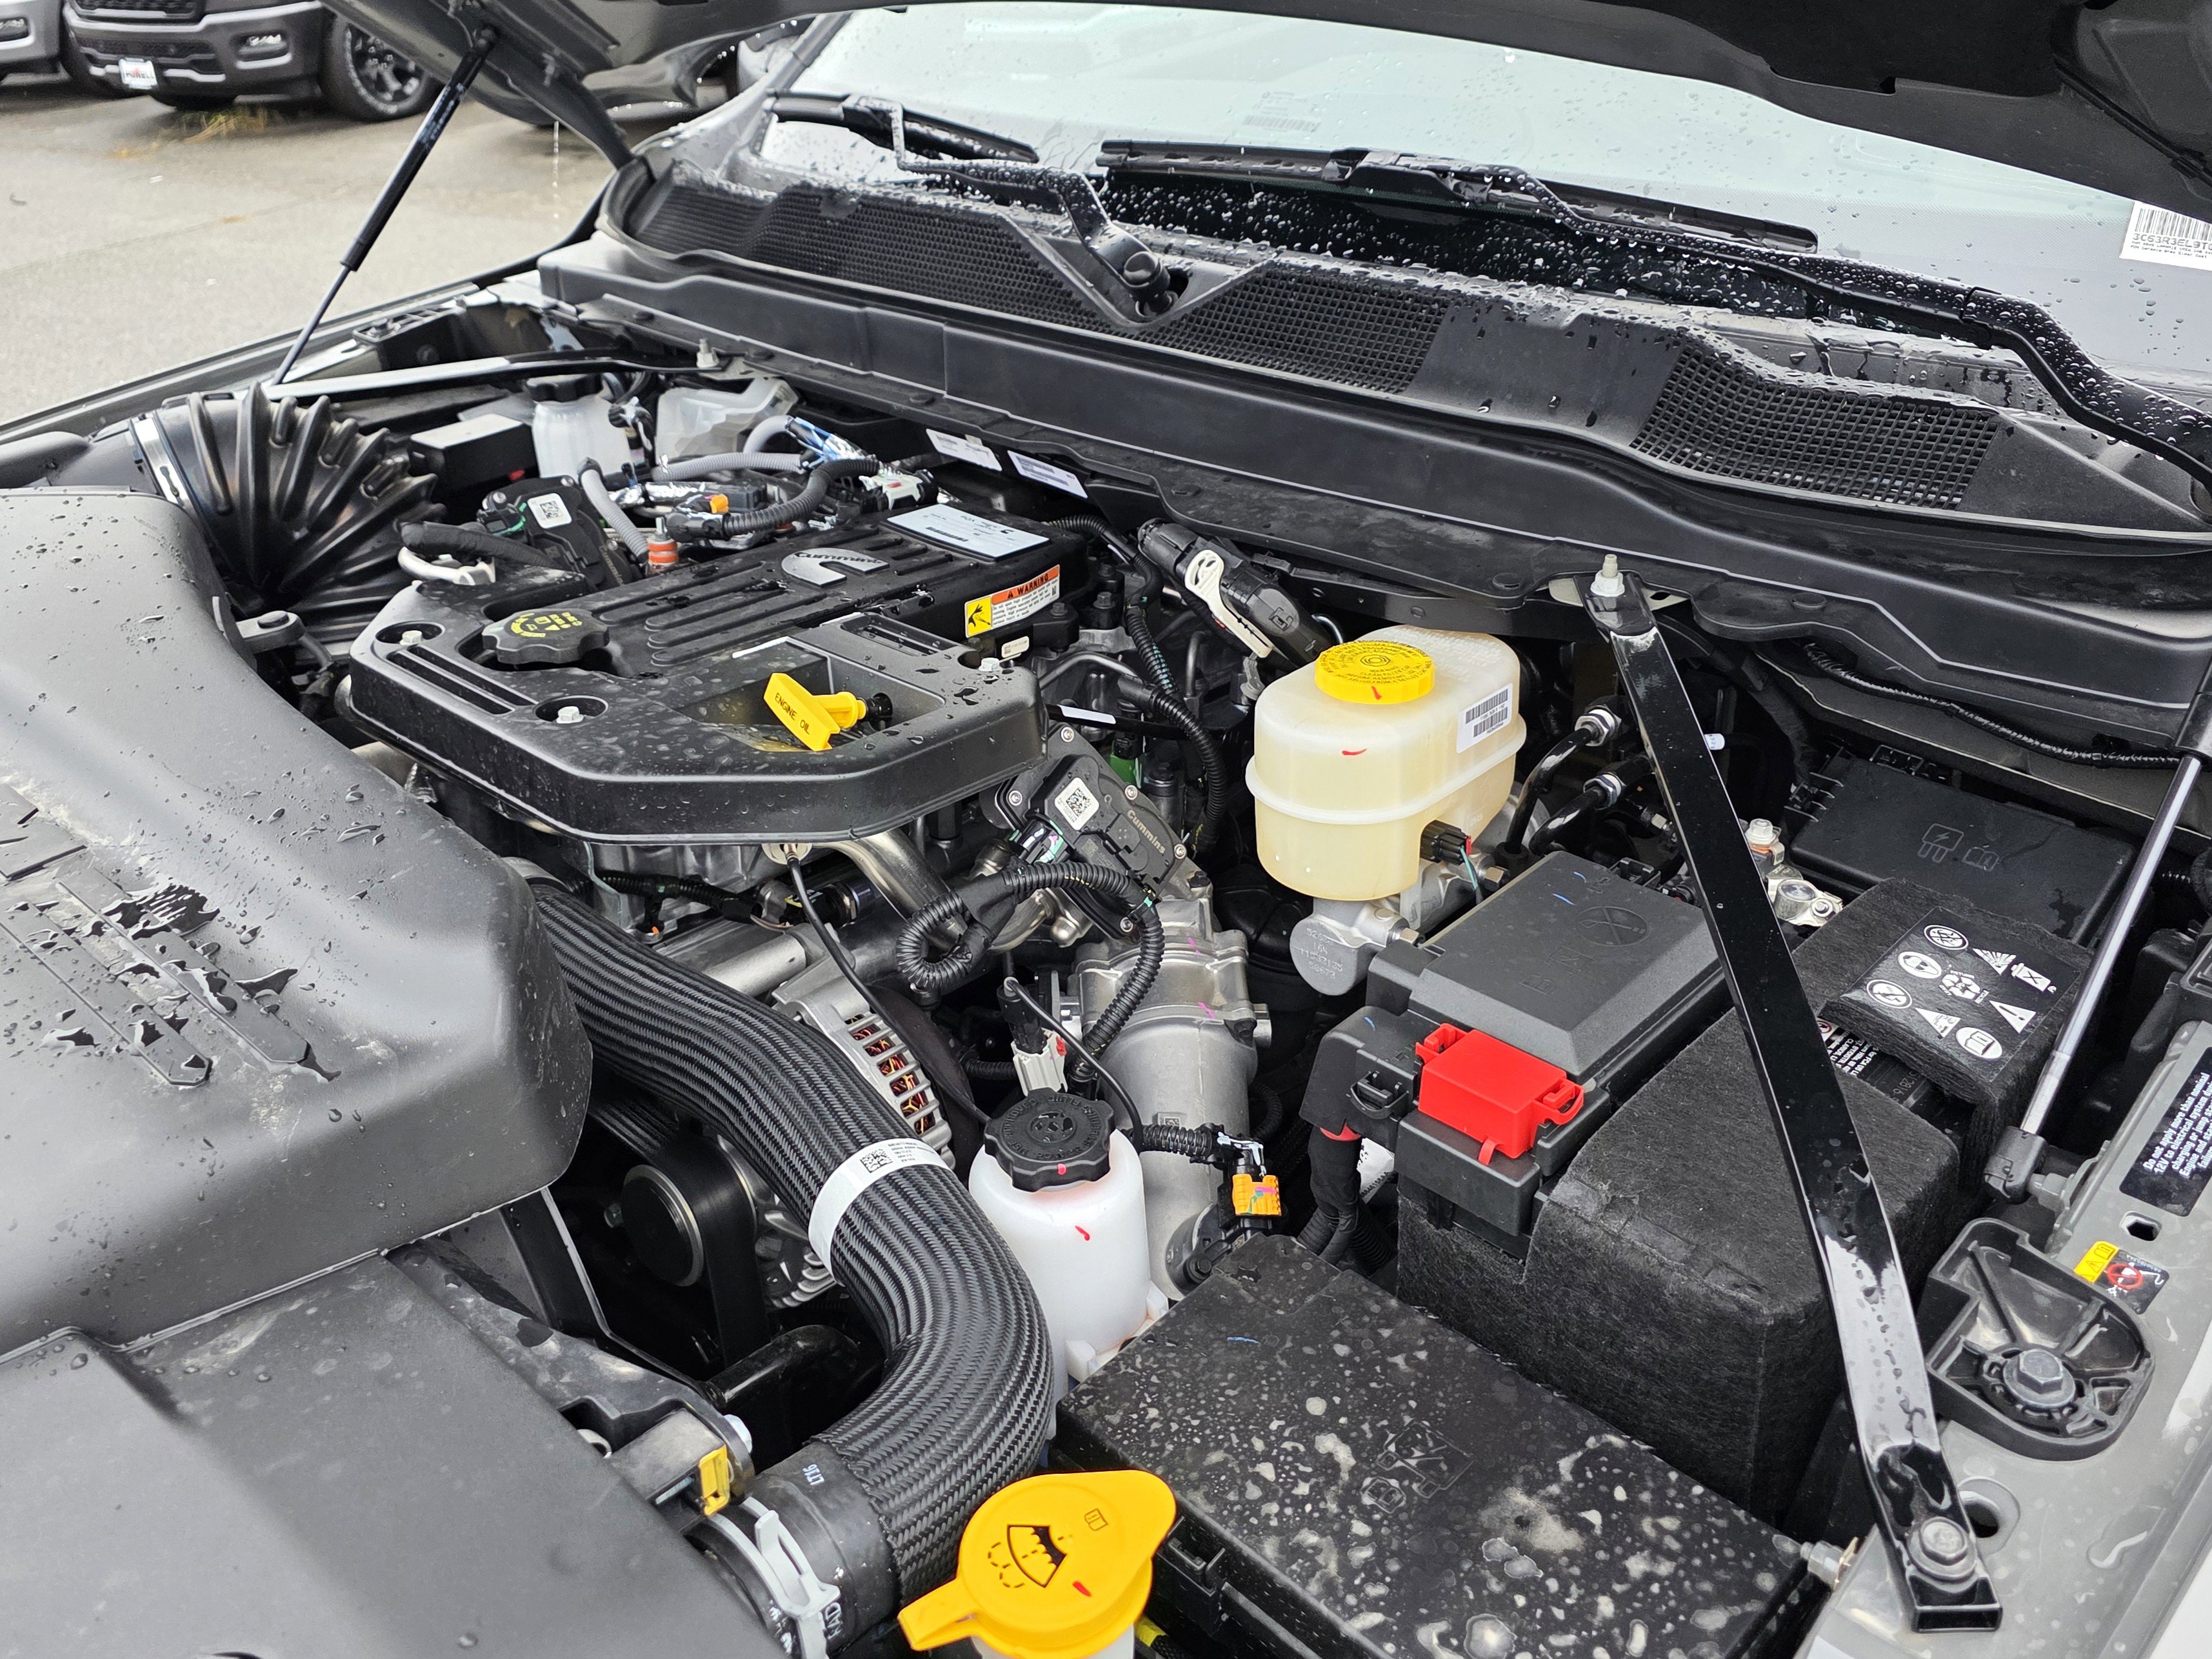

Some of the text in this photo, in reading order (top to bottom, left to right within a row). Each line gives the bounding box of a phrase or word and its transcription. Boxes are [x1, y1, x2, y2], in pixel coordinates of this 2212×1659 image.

[1017, 573, 1048, 595] WARNING
[775, 692, 810, 735] ENGINE OIL
[1127, 809, 1166, 854] Cummins
[2142, 1072, 2210, 1172] Do not apply more than nominal
[2154, 1158, 2169, 1175] 12V
[2164, 1148, 2175, 1160] to
[2171, 1118, 2194, 1151] electrical
[2189, 1096, 2208, 1120] system
[2189, 1132, 2198, 1141] or
[2191, 1116, 2210, 1134] jump
[2171, 1140, 2196, 1171] charging
[2178, 1153, 2200, 1177] Engine
[2195, 1139, 2207, 1154] and
[802, 1463, 825, 1485] LT16
